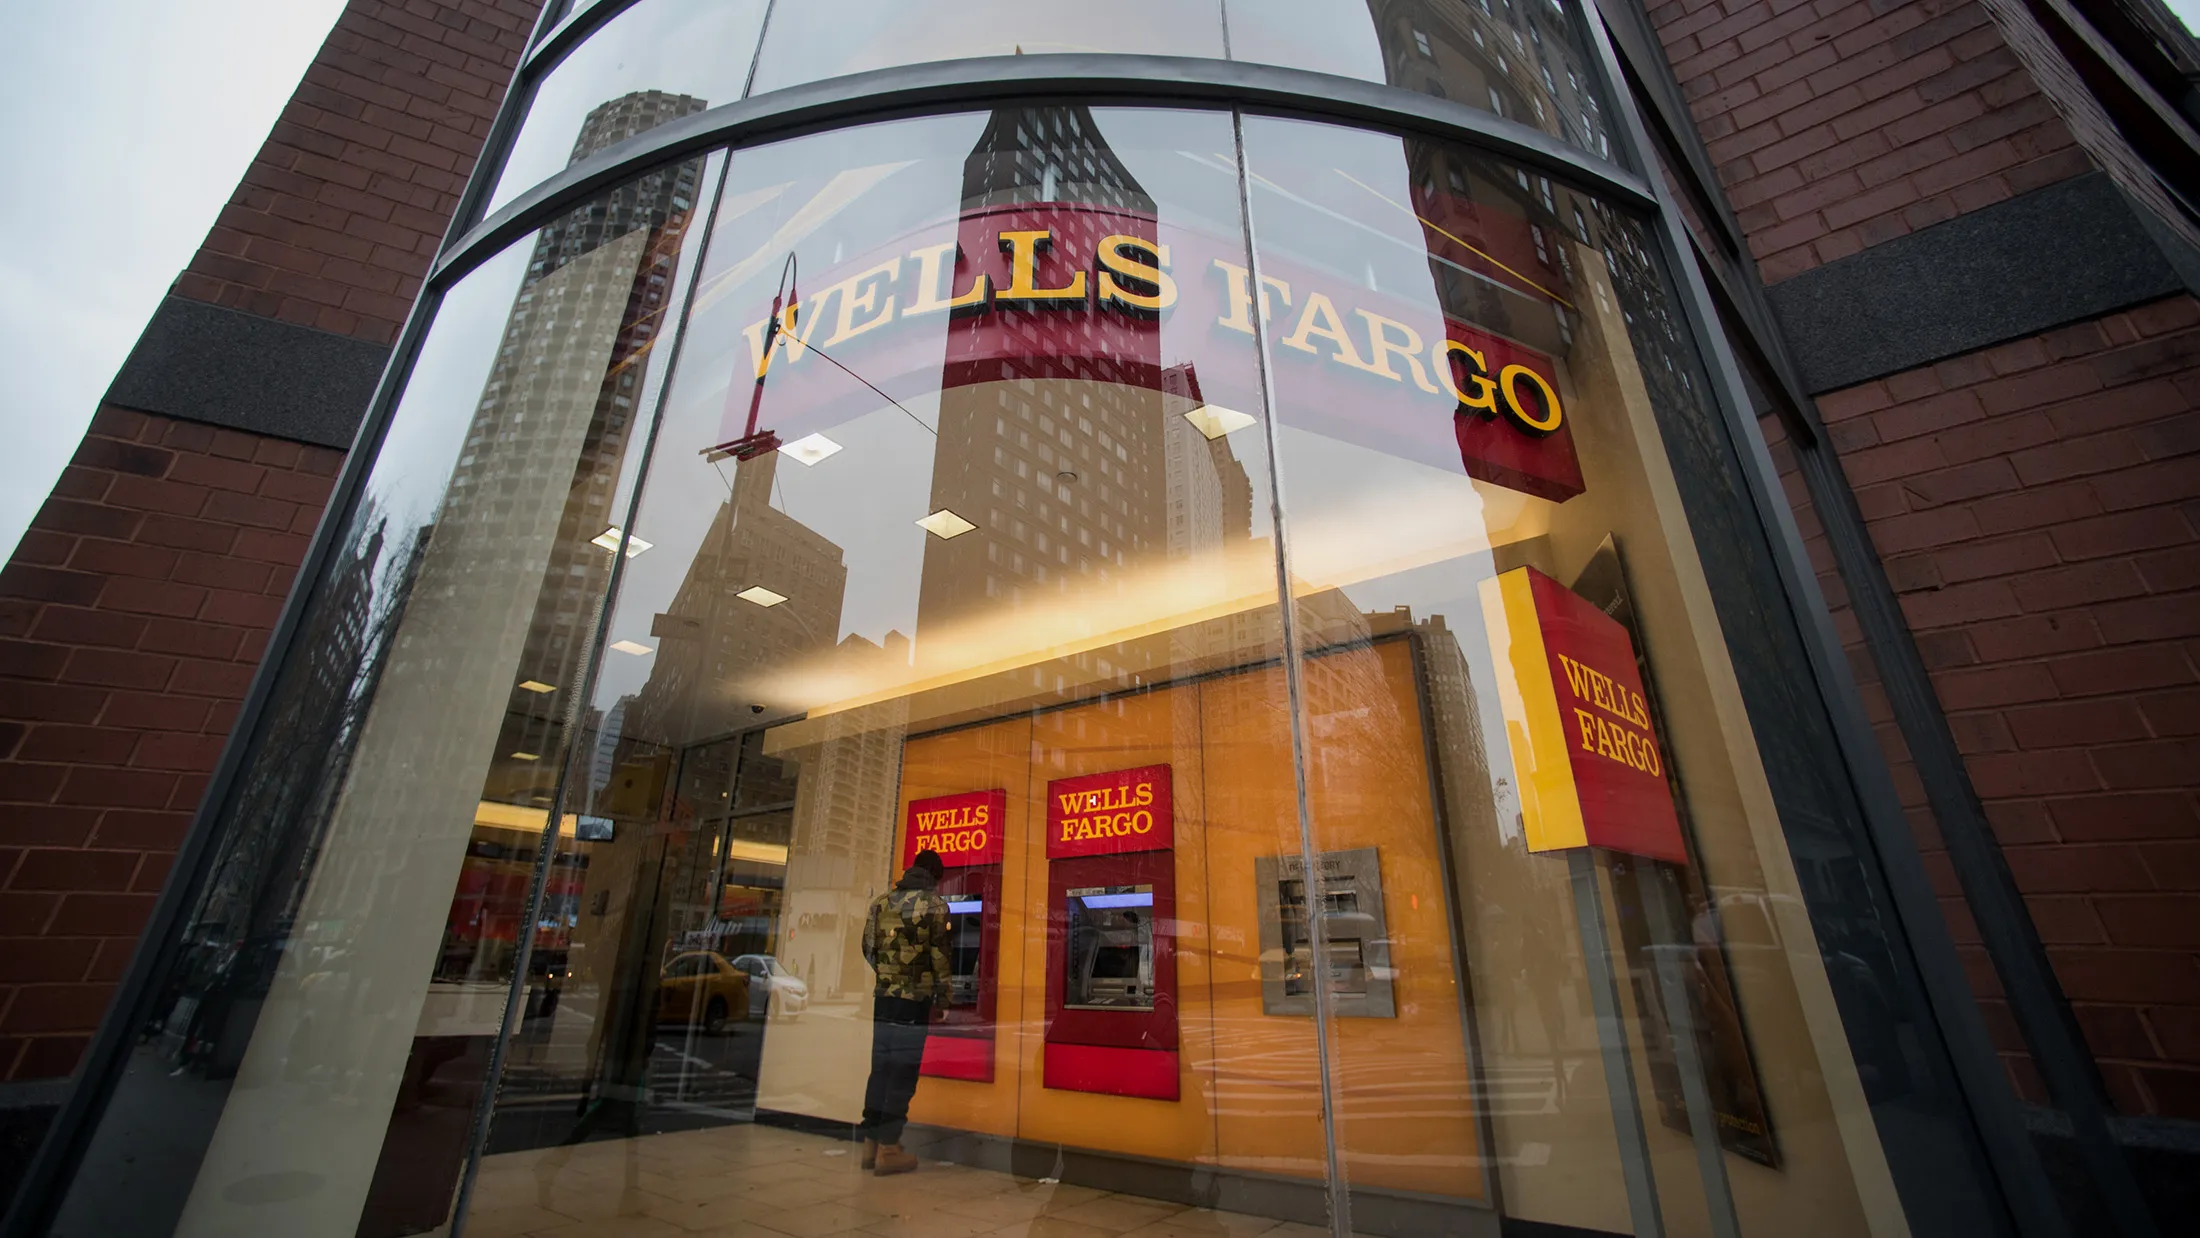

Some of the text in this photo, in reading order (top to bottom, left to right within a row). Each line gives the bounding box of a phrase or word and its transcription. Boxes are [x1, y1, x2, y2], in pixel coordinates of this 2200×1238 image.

[743, 229, 1563, 432] WELLS FARGO
[1557, 652, 1649, 732] WELLS
[1573, 707, 1661, 778] FARGO
[1059, 782, 1154, 816] WELLS
[916, 804, 989, 832] WELLS
[1060, 810, 1153, 843] FARGO
[915, 829, 987, 855] FARGO
